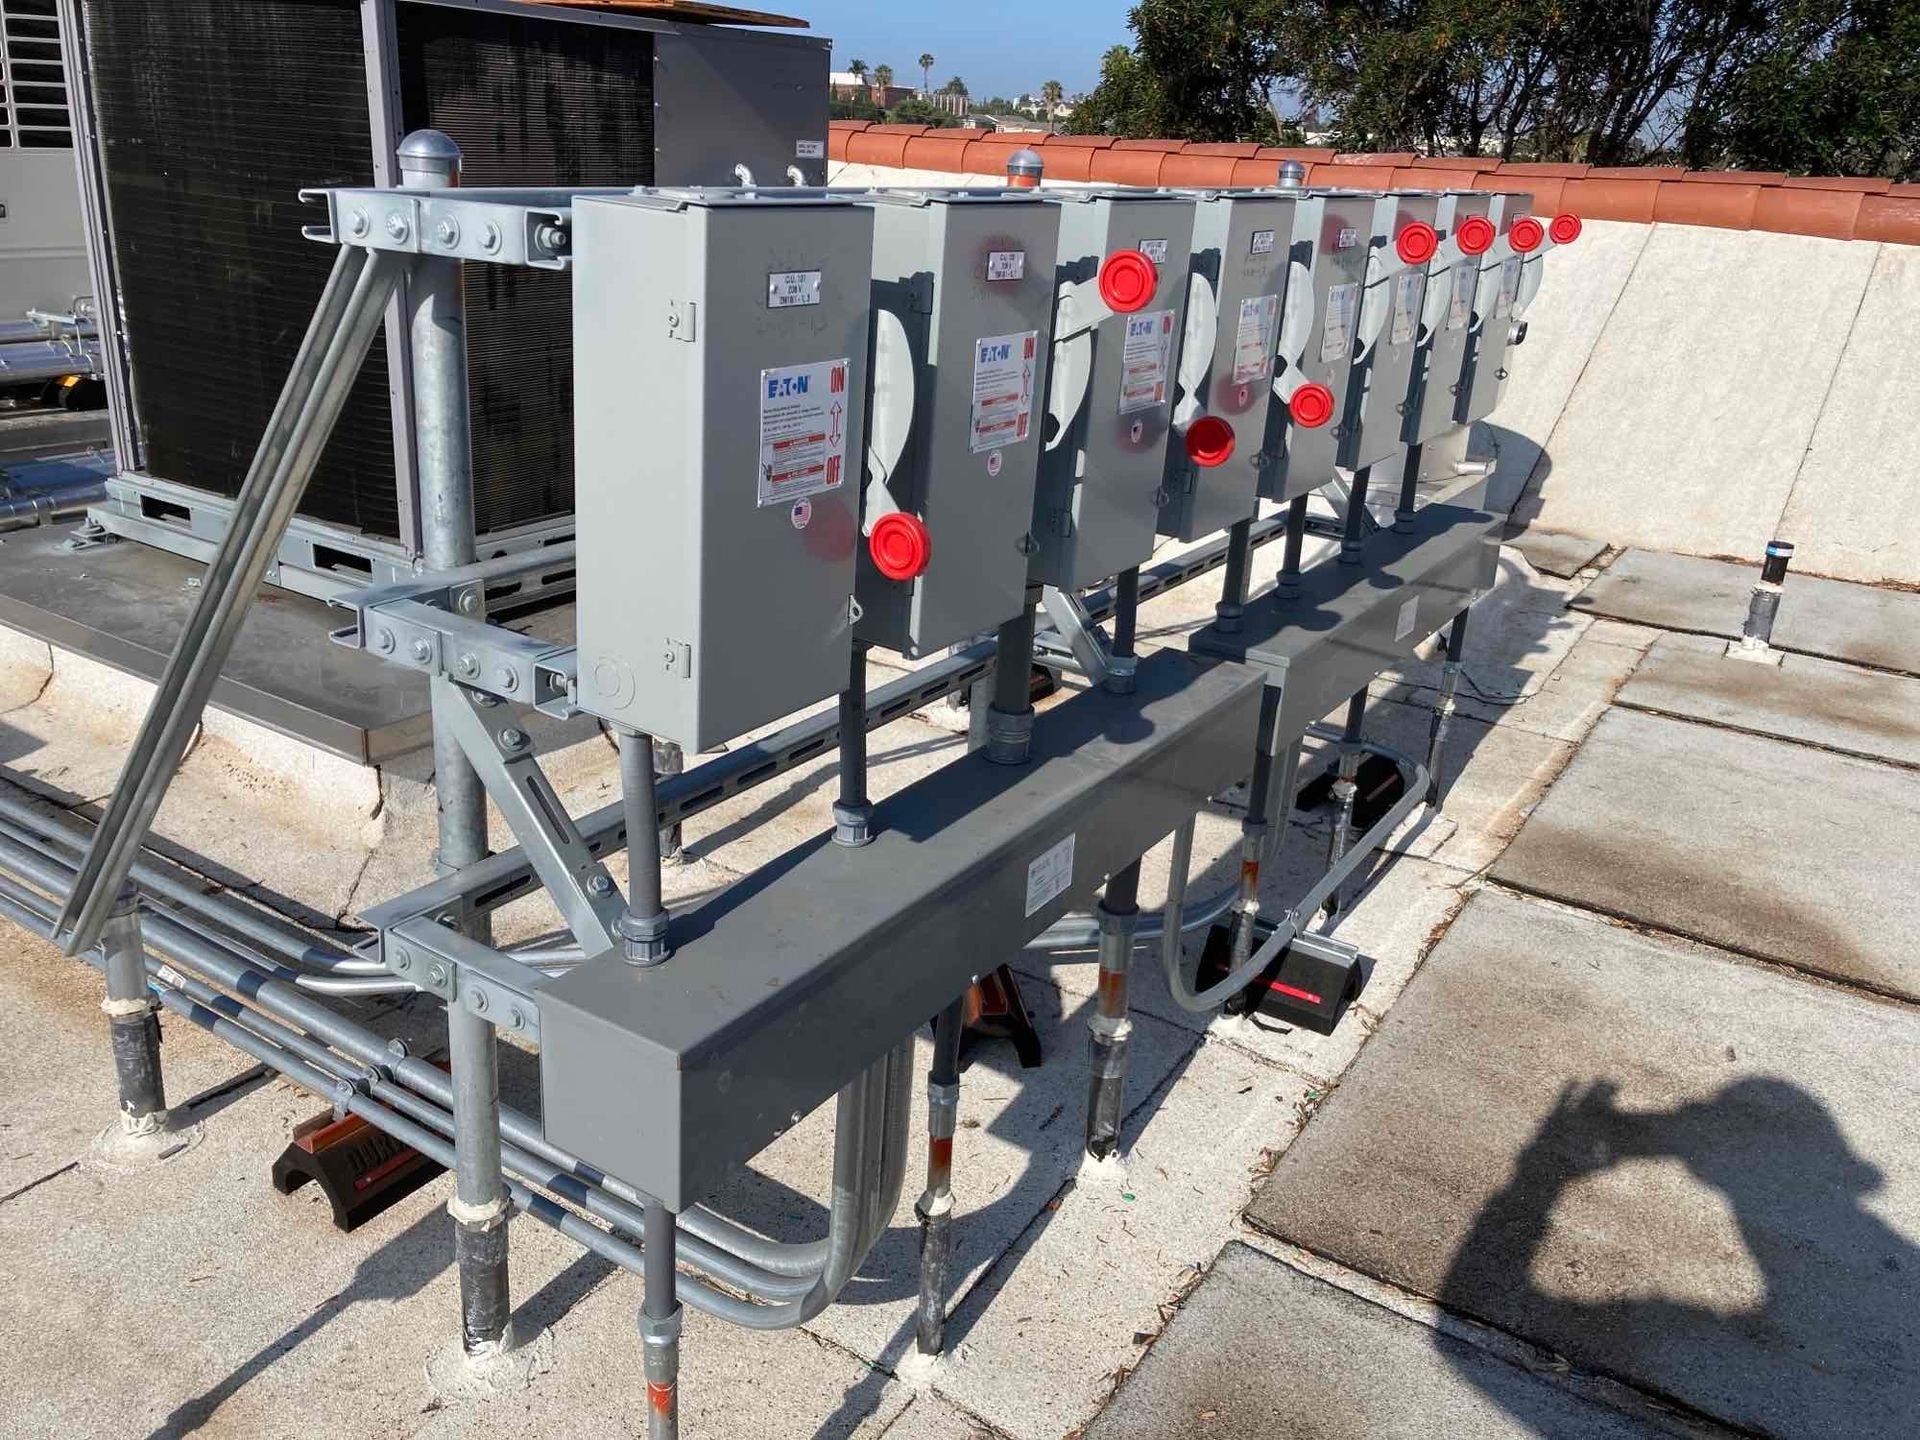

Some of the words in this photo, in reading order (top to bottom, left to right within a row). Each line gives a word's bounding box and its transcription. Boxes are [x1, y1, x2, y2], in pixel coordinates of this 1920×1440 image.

[1023, 337, 1035, 360] ON
[767, 375, 809, 399] EATON
[830, 366, 845, 394] ON
[826, 455, 841, 485] OFF
